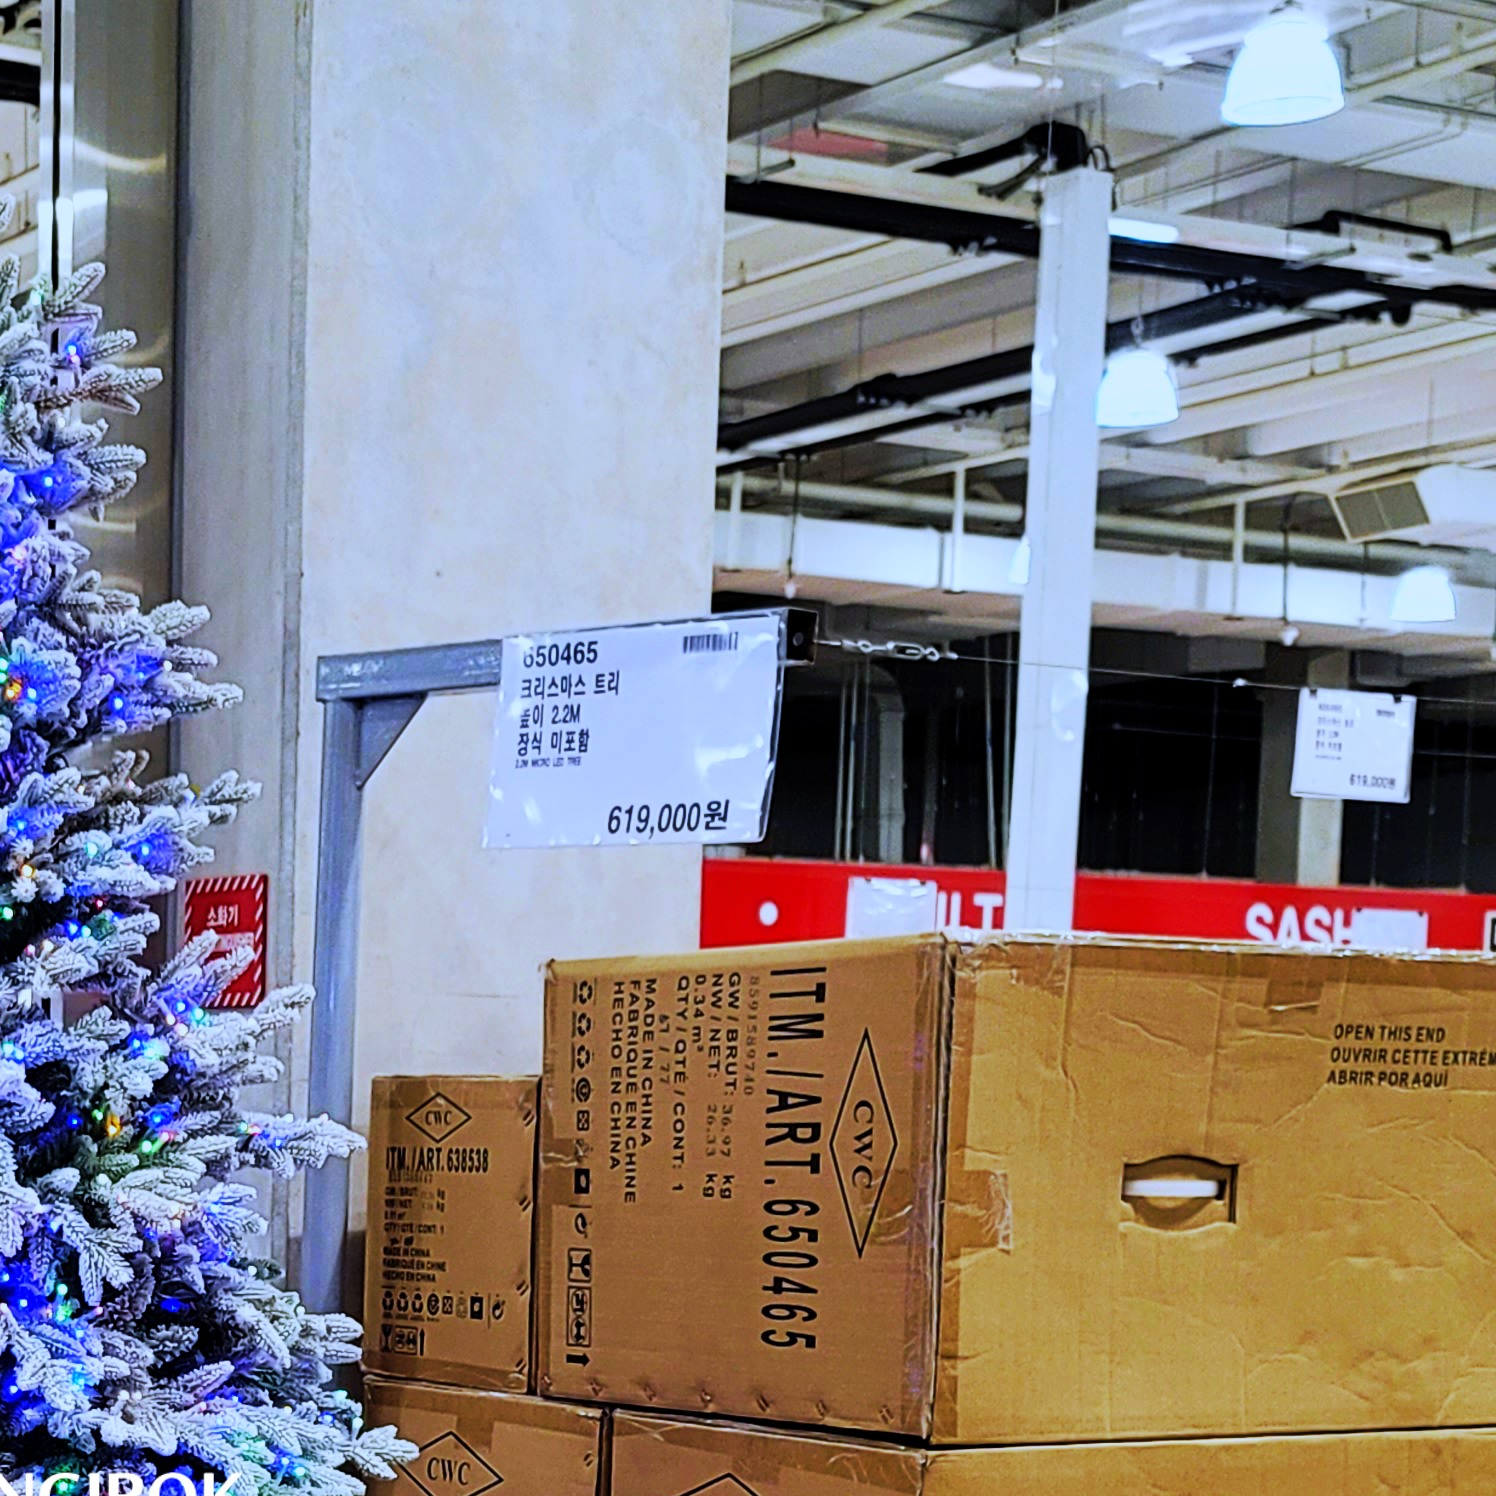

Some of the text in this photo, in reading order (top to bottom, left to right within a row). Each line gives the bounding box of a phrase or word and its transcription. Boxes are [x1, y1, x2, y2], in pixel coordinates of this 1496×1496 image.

[523, 641, 599, 668] 650465
[520, 670, 620, 700] 크리스마스 트리
[520, 703, 581, 729] 높이 2.2M
[517, 729, 590, 757] 장식 미포함
[607, 799, 730, 838] 619,000원
[206, 903, 239, 928] 소화기
[1334, 1024, 1446, 1043] OPEN THIS END
[641, 978, 657, 1147] MADE IN CHINA
[1330, 1047, 1388, 1063] OUVRIR
[1391, 1049, 1439, 1066] CETTE
[610, 981, 625, 1170] HECHO EN CHINA
[1327, 1069, 1375, 1086] ABRIR
[1378, 1071, 1409, 1088] POR
[625, 1101, 637, 1129] EN
[851, 1099, 875, 1190] CWC
[624, 1136, 636, 1204] CHINE
[760, 1198, 820, 1350] 650465
[427, 1457, 471, 1487] CWC
